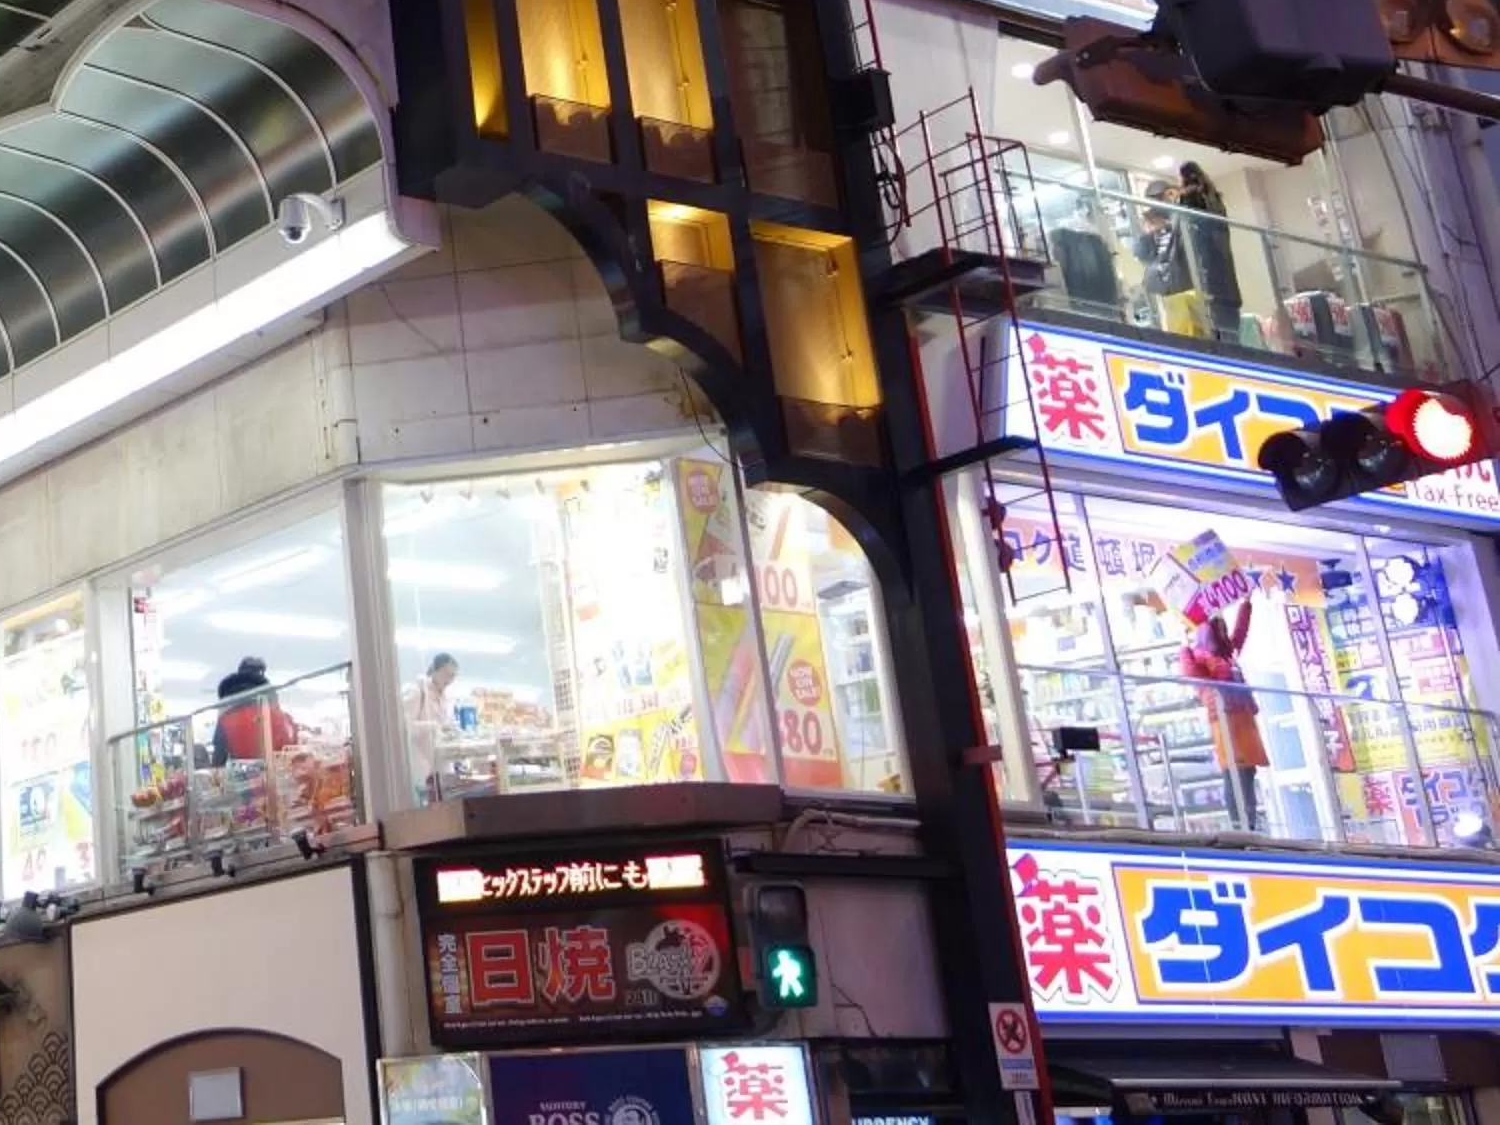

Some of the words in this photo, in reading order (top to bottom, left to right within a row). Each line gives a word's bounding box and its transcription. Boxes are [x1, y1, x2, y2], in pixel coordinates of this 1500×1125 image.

[1026, 333, 1106, 446] 薬
[466, 926, 617, 1007] 日焼
[1015, 854, 1113, 995] 薬
[1140, 880, 1500, 994] ダイコ
[720, 1051, 789, 1122] 薬
